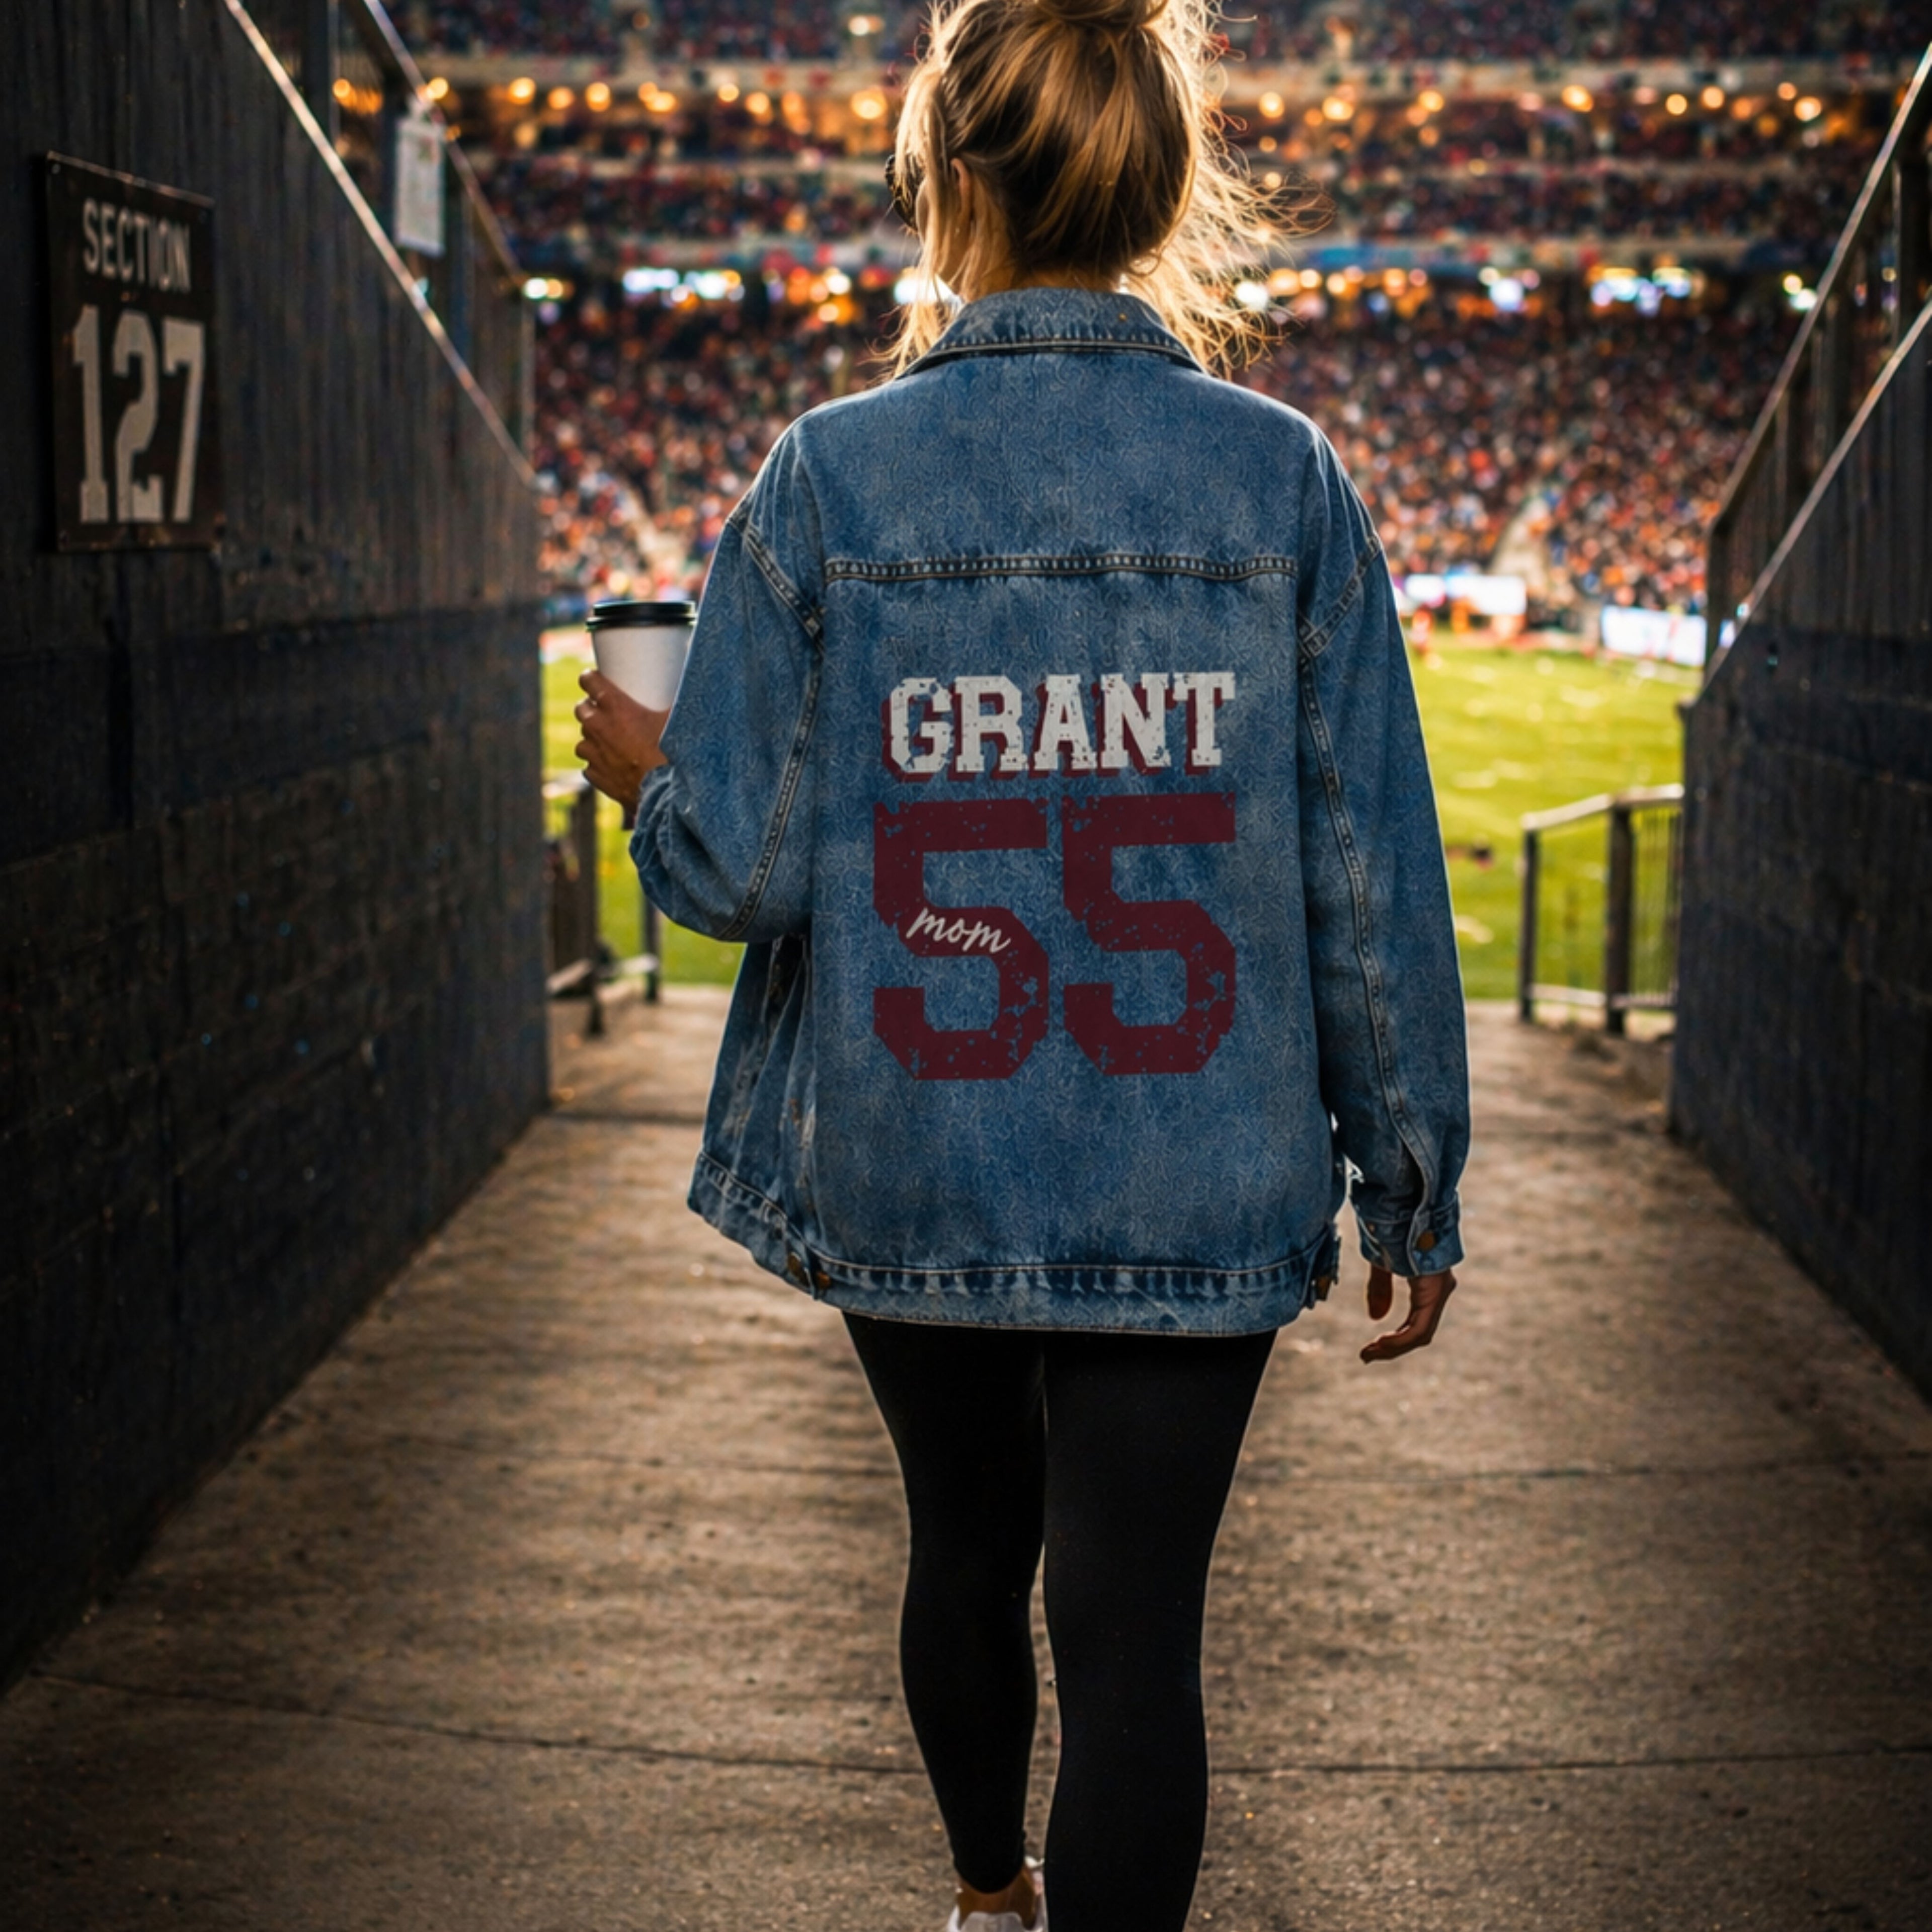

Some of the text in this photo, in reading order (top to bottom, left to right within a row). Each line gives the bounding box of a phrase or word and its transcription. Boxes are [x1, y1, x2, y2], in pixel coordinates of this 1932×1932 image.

[83, 197, 191, 290] SECTION
[73, 304, 205, 523] 127
[882, 671, 1235, 782] GRANT
[873, 792, 1236, 1080] 55
[906, 907, 1011, 953] mom
